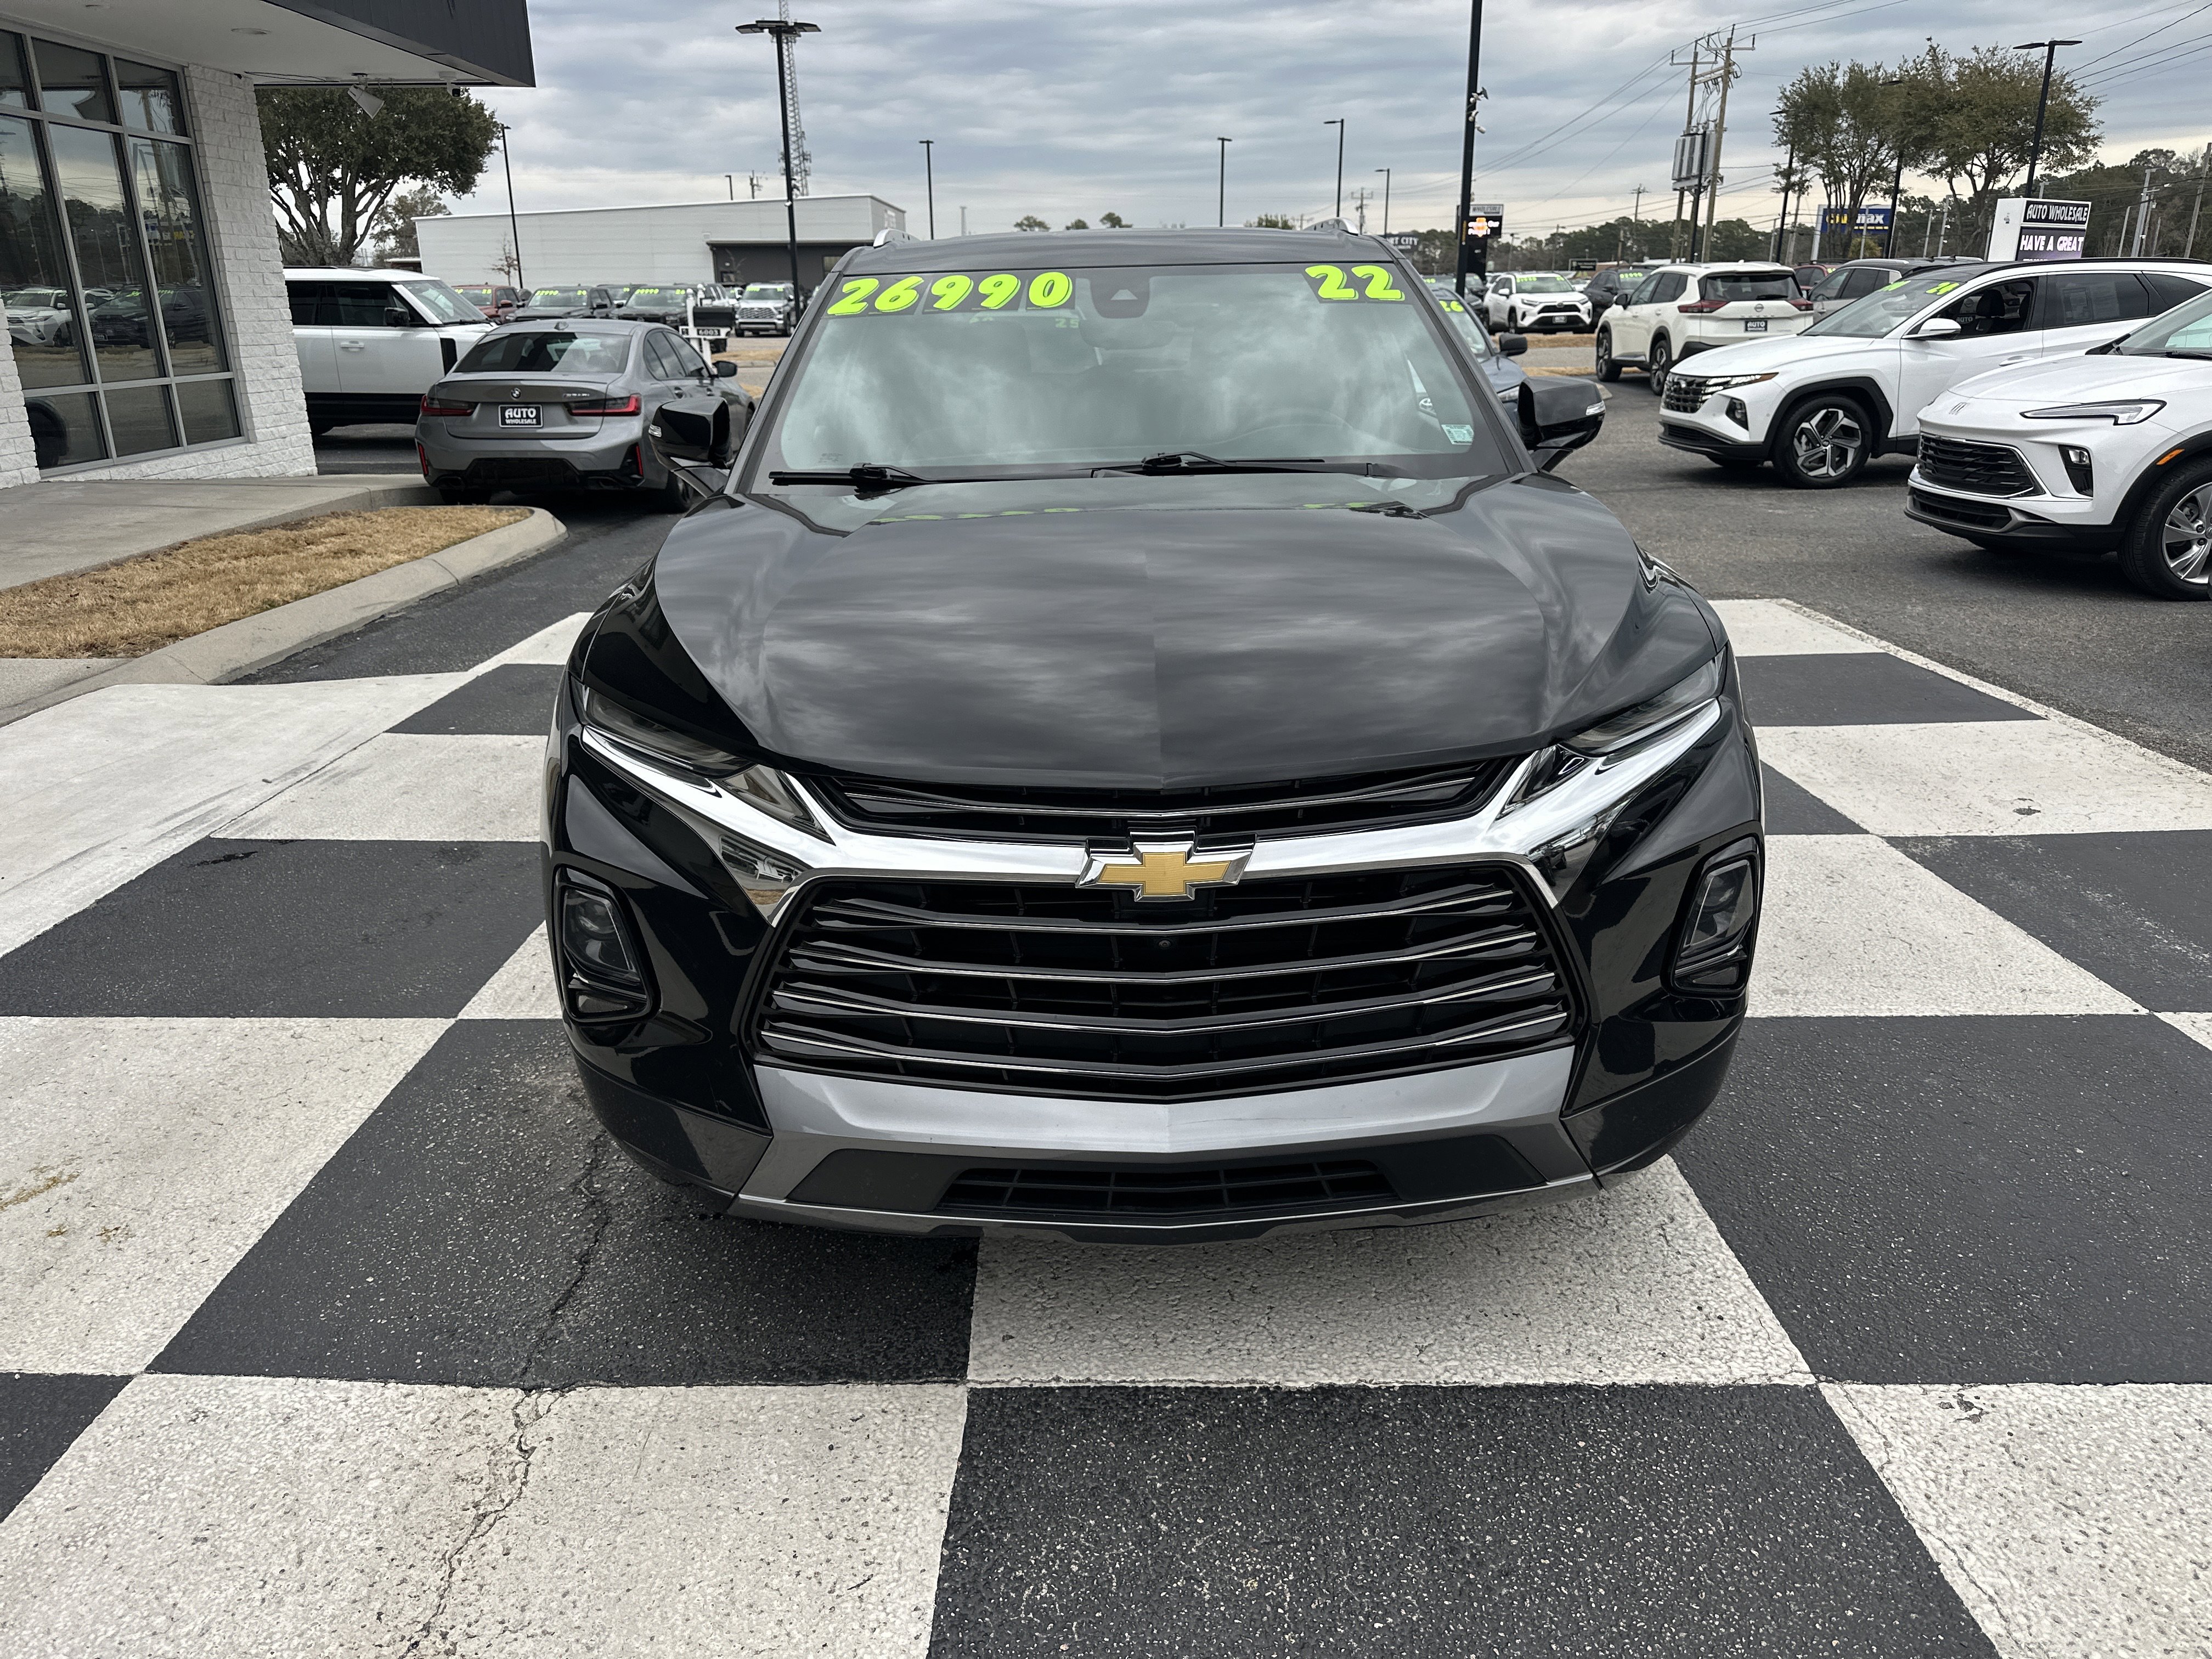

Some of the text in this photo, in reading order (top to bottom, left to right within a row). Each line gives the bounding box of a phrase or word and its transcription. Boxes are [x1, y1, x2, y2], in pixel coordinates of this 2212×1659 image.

[2027, 204, 2089, 222] AUTO WHOLESALE
[2019, 235, 2085, 251] HAVE A GREAT
[1305, 264, 1406, 301] 22
[827, 272, 1073, 316] 26990
[1055, 318, 1080, 328] 25
[505, 408, 537, 419] AUTO
